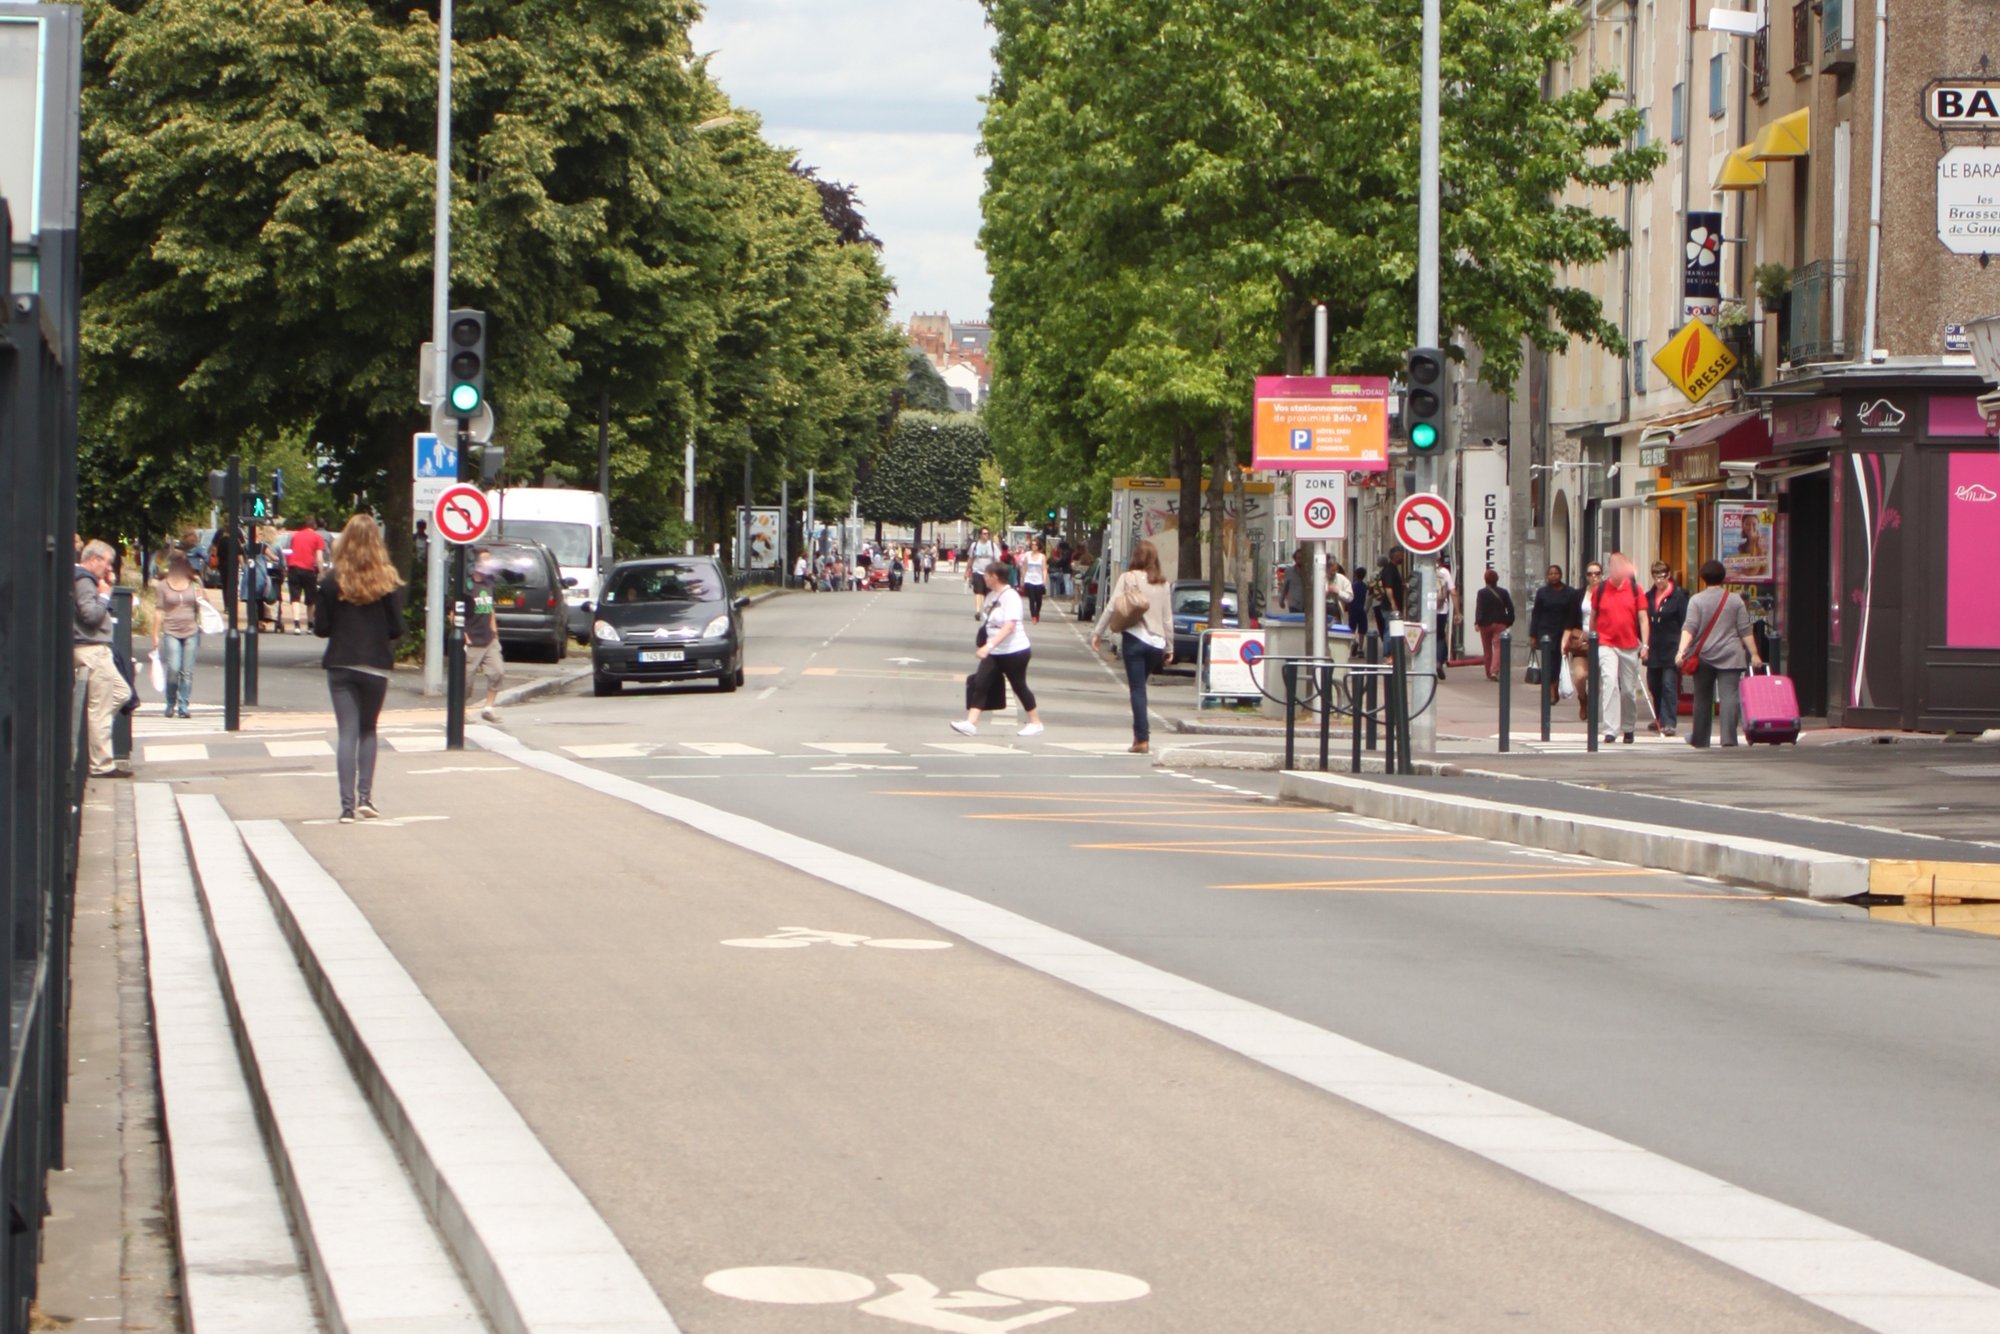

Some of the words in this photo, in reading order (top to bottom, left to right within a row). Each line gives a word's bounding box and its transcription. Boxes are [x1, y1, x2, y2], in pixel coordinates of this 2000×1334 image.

[1942, 163, 1958, 178] LE
[1977, 195, 1993, 204] les
[1949, 225, 1963, 234] de
[1688, 353, 1732, 396] PRESSE
[1273, 403, 1289, 412] Vos
[1273, 414, 1285, 422] de
[1287, 414, 1331, 424] proximité
[1333, 414, 1368, 423] 24h/24
[1294, 430, 1308, 450] P
[1305, 479, 1335, 489] ZONE
[1310, 506, 1330, 521] 30
